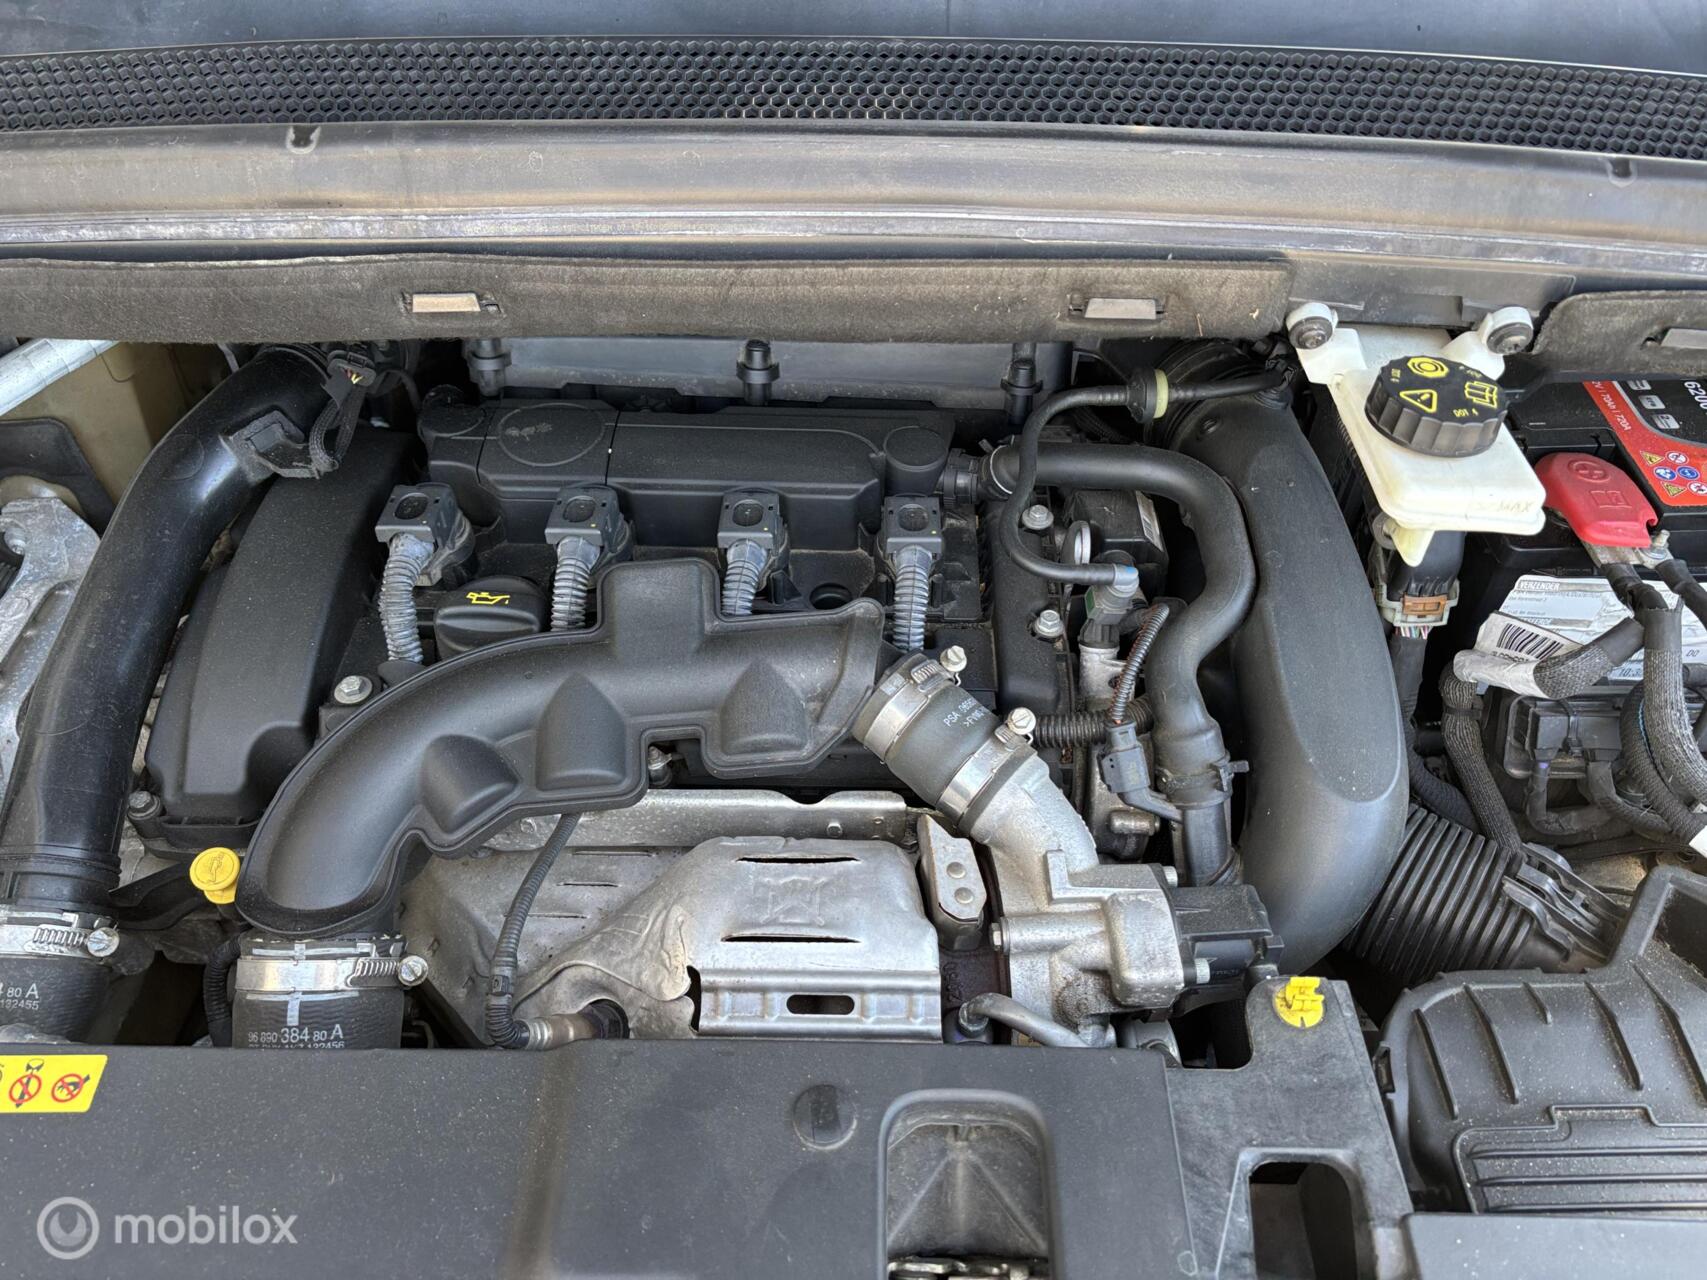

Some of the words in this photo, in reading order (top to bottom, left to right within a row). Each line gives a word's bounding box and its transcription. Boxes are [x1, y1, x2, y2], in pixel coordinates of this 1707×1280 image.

[943, 711, 961, 727] PSA
[7, 986, 22, 998] 80
[25, 982, 39, 999] A
[248, 1032, 258, 1043] 96
[260, 1032, 278, 1043] 890
[280, 1027, 310, 1043] 384
[313, 1031, 328, 1041] 80
[330, 1023, 344, 1040] A
